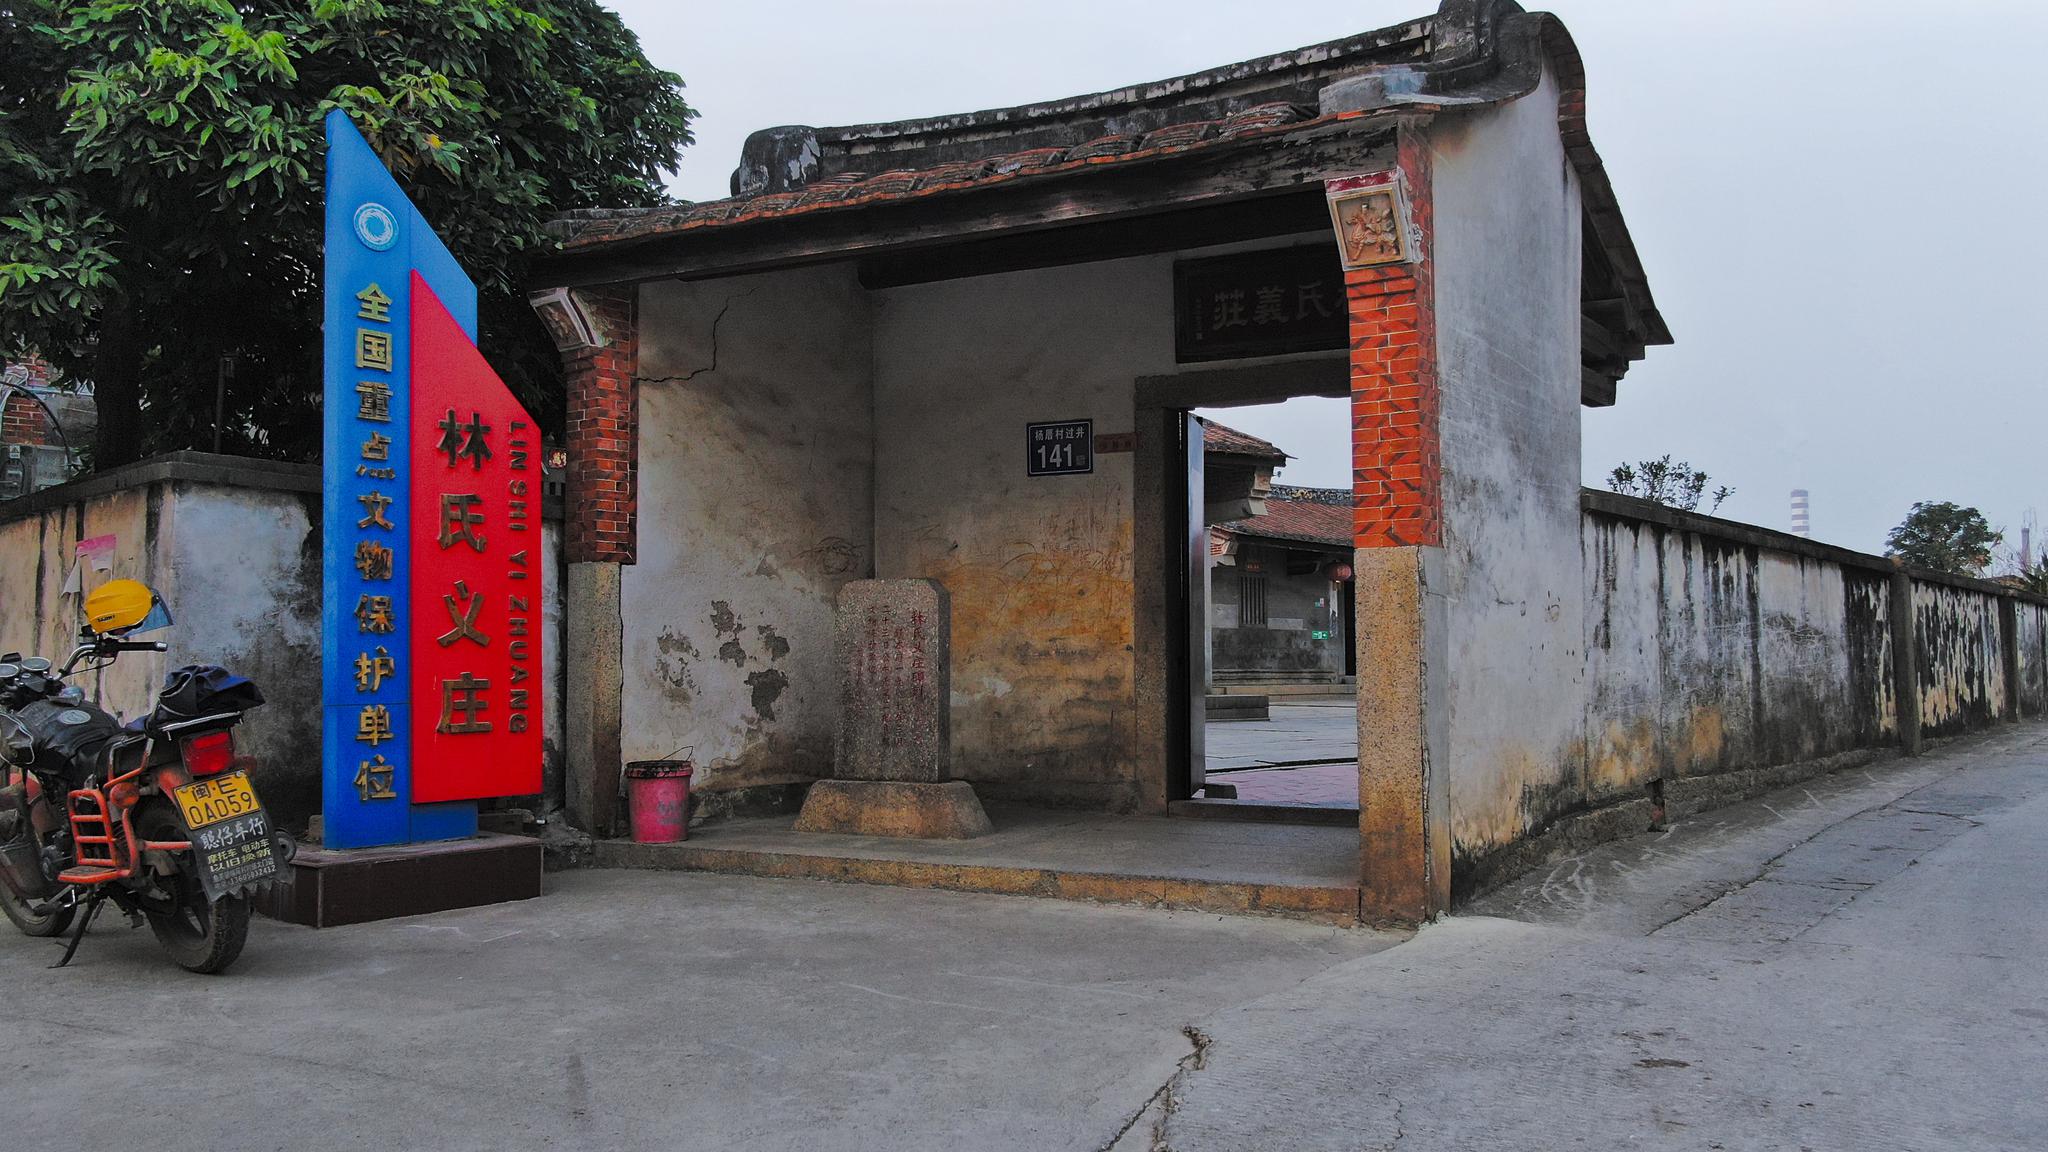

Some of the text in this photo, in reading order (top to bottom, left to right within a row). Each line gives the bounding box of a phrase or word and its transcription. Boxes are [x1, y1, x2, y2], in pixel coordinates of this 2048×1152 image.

[1037, 443, 1072, 469] 141
[355, 281, 397, 801] 全国重点文物保护单位
[436, 407, 493, 735] 林氏义庄
[508, 550, 527, 579] YI
[508, 594, 529, 734] ZHUANG
[210, 847, 272, 872] 以旧换新
[241, 838, 270, 853] 电动车
